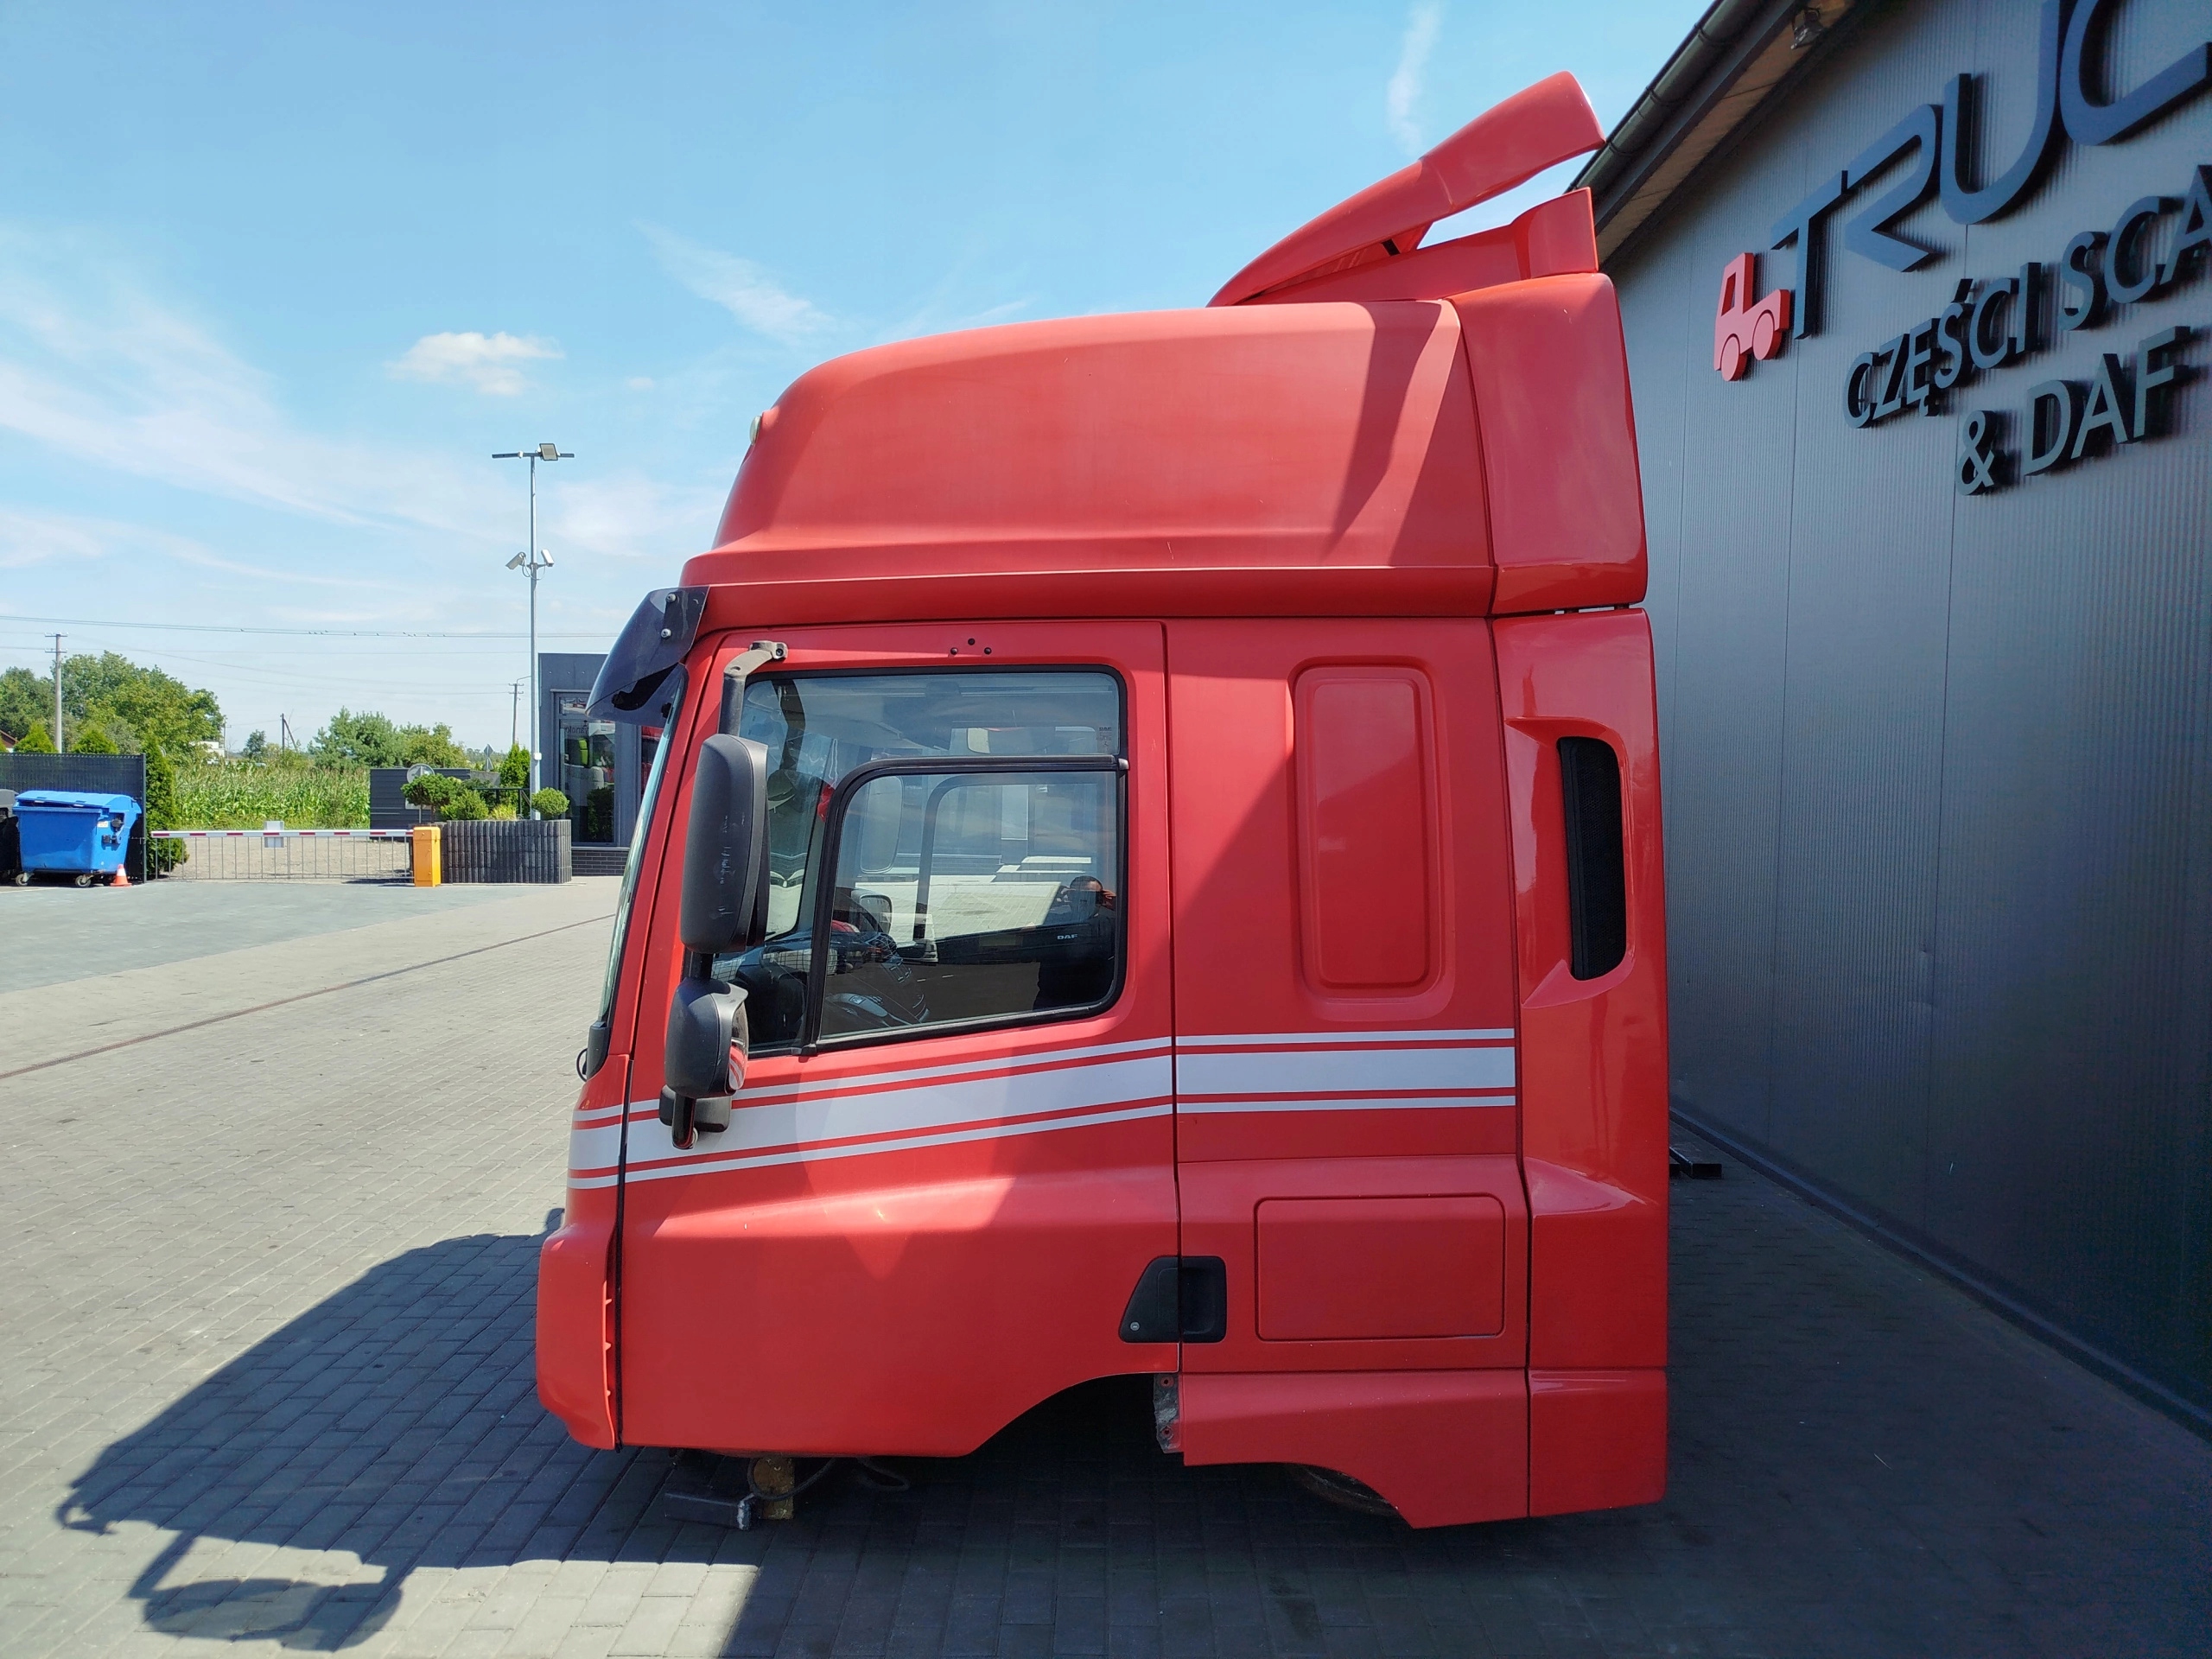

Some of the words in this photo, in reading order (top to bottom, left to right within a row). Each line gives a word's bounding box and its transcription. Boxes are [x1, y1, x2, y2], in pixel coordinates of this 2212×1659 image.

[1843, 262, 2040, 429] CZĘŚCI
[2059, 165, 2212, 331] SCA
[1956, 410, 1996, 495] &
[2024, 327, 2188, 476] DAF
